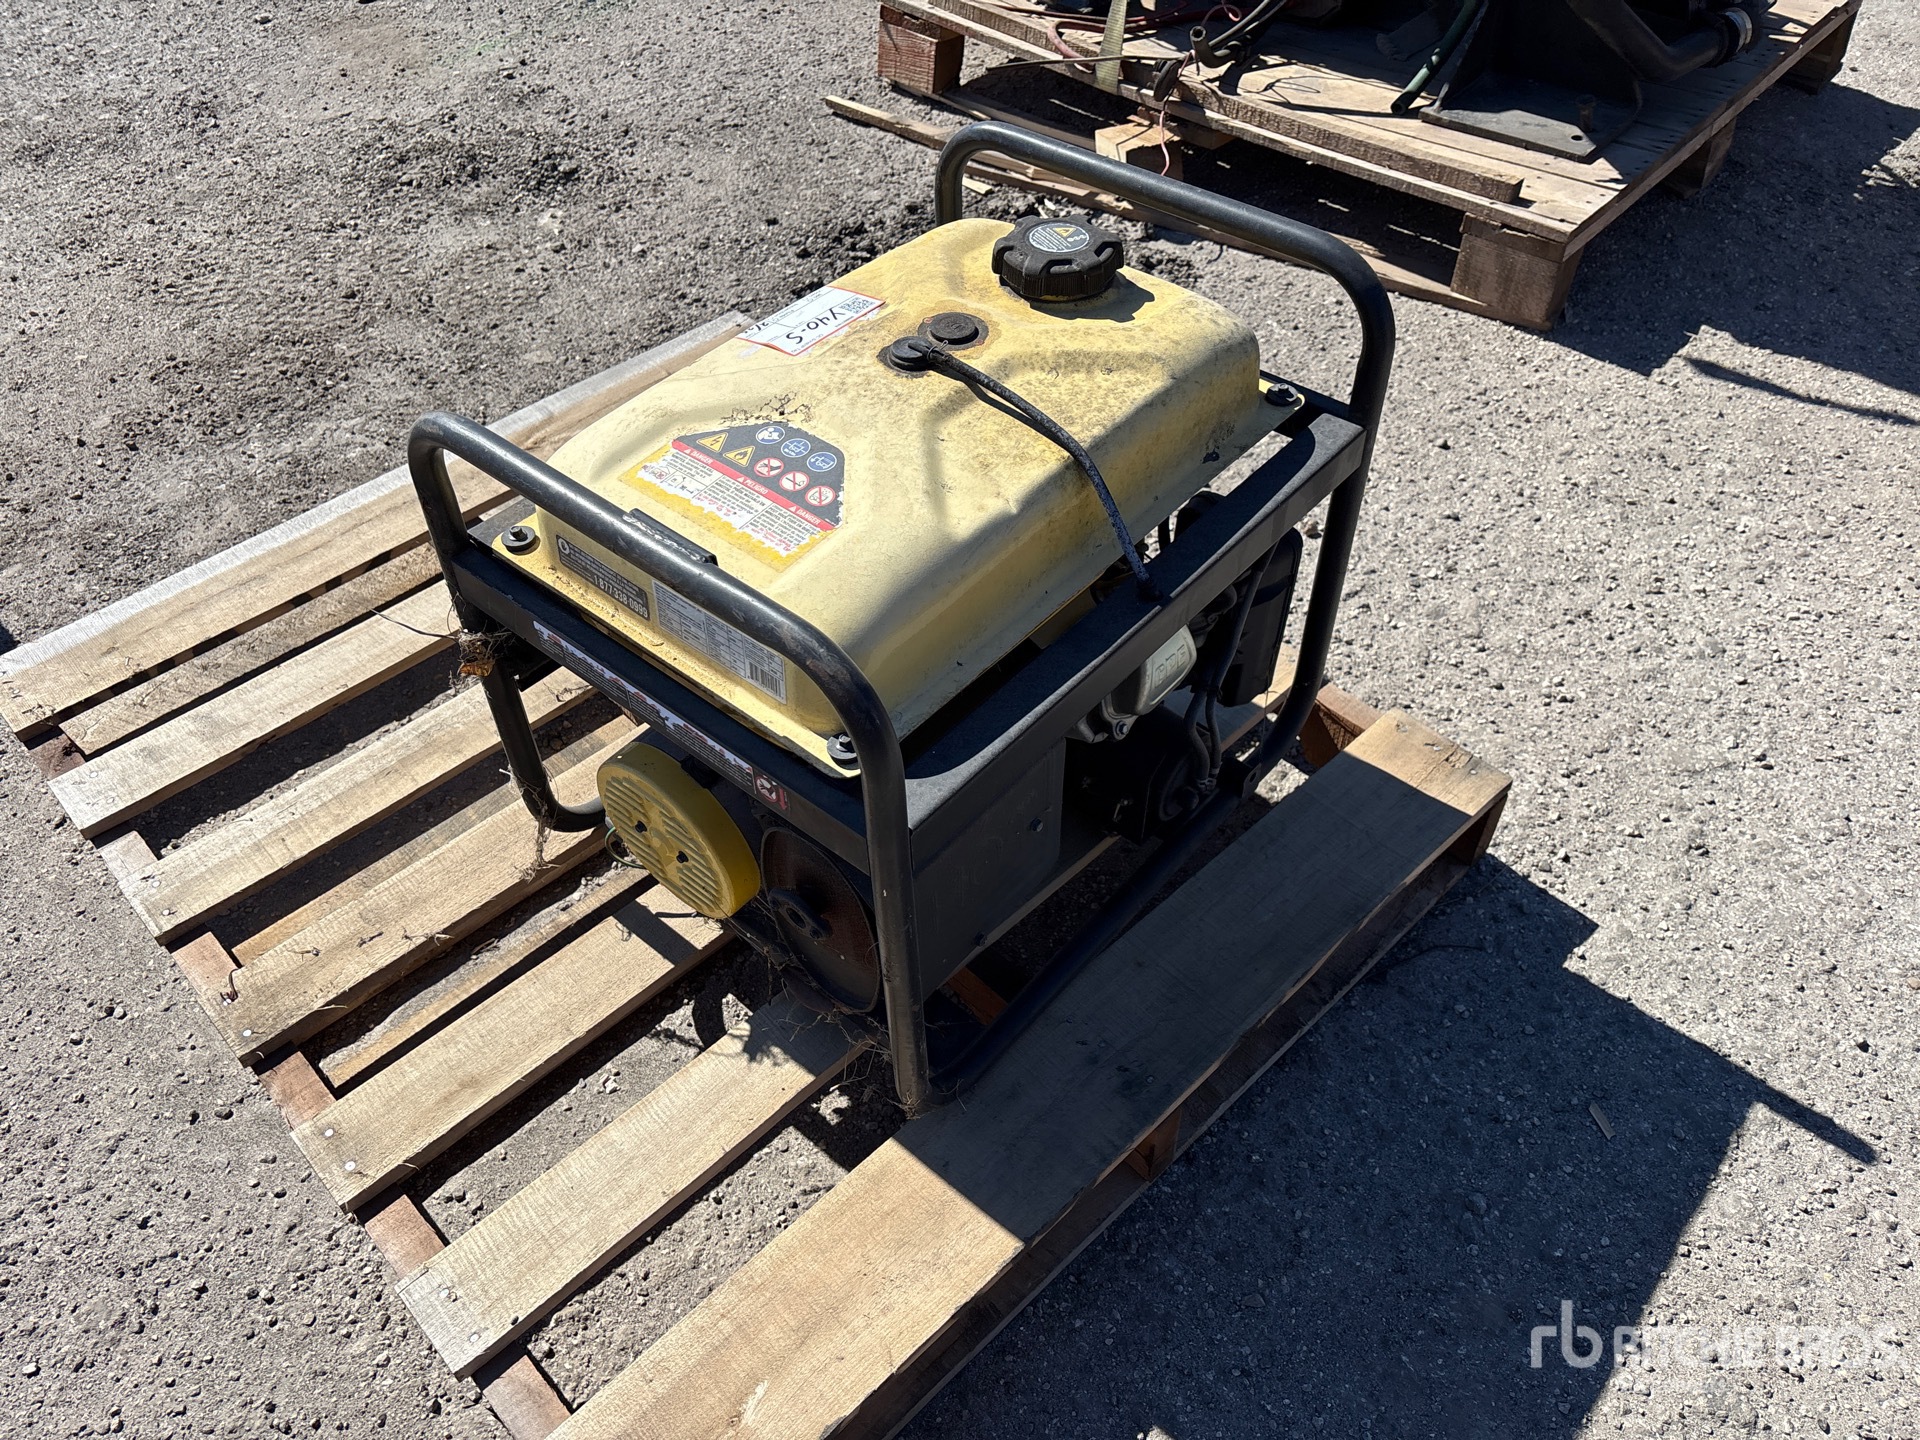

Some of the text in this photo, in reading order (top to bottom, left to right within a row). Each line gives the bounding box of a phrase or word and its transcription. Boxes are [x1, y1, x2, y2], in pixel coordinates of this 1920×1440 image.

[786, 308, 846, 344] Y40-S
[691, 450, 714, 465] DANGER
[744, 478, 769, 494] PELIGRO
[796, 508, 822, 526] DANGER
